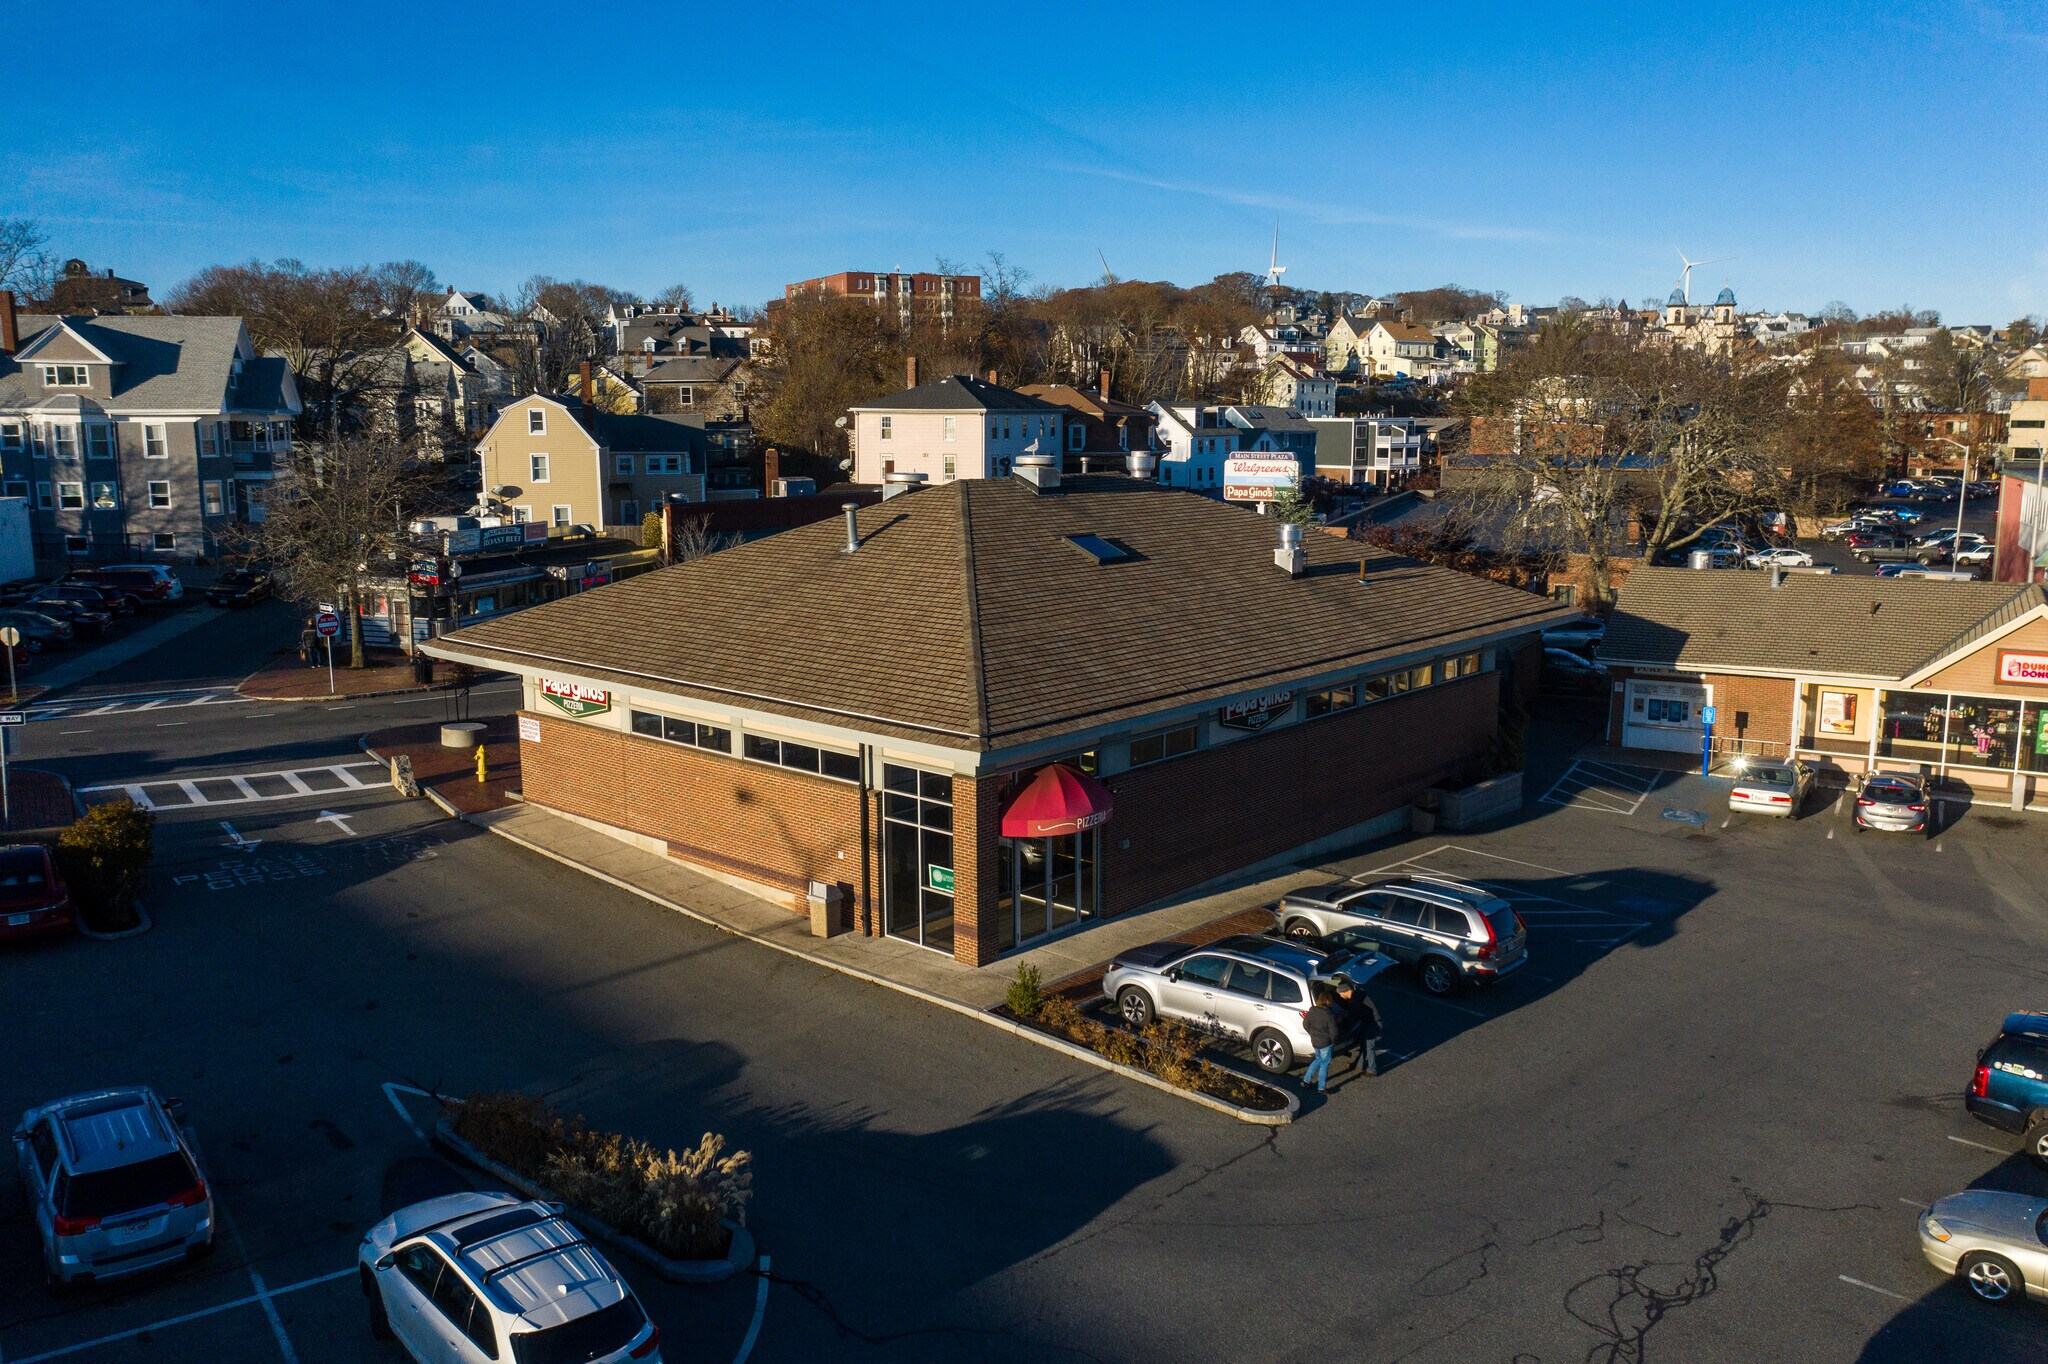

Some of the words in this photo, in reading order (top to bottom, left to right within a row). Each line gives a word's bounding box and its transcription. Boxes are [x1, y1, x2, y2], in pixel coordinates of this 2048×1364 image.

[1233, 461, 1289, 475] Walgreens
[1226, 486, 1248, 498] Papa
[1249, 486, 1273, 499] Gino's
[483, 536, 505, 547] ROAST
[505, 535, 522, 543] BEEF
[2022, 662, 2048, 671] DUN
[543, 678, 570, 698] Papa
[563, 699, 584, 712] PIZZERIA
[1077, 810, 1106, 830] PIZZERIA
